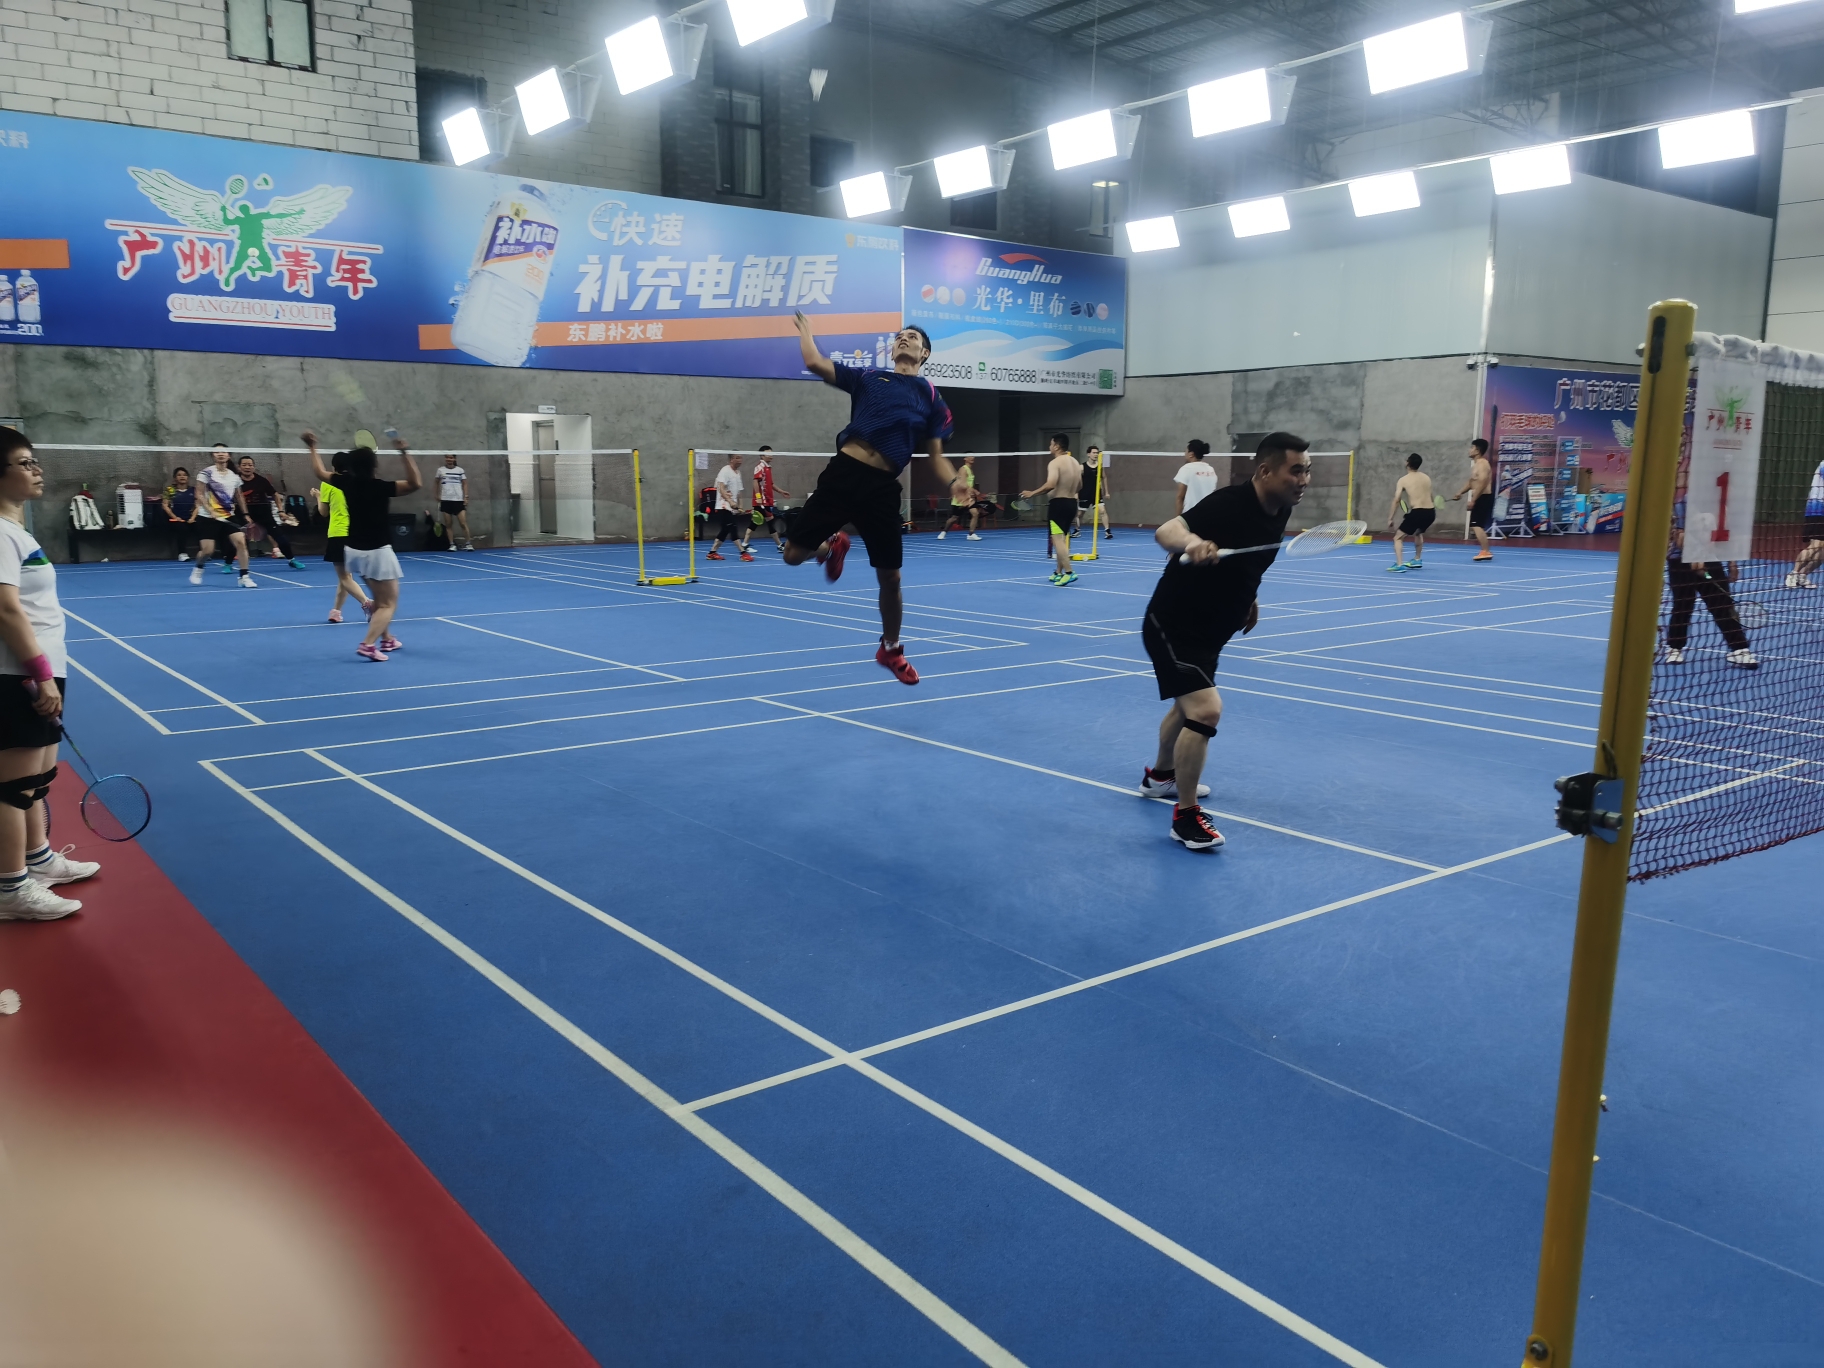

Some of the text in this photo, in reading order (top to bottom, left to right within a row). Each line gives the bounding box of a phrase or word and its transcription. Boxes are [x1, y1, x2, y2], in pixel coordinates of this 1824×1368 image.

[610, 211, 684, 246] 快速
[118, 229, 378, 297] 广州青年
[975, 257, 1063, 285] GuangHua
[574, 254, 839, 313] 补充电解质
[170, 297, 332, 321] GUANGZHOU YOUTH
[567, 322, 664, 342] 东鹏补水啦
[923, 362, 972, 380] 86923508
[990, 367, 1036, 384] 60765888
[1711, 471, 1730, 542] 1
